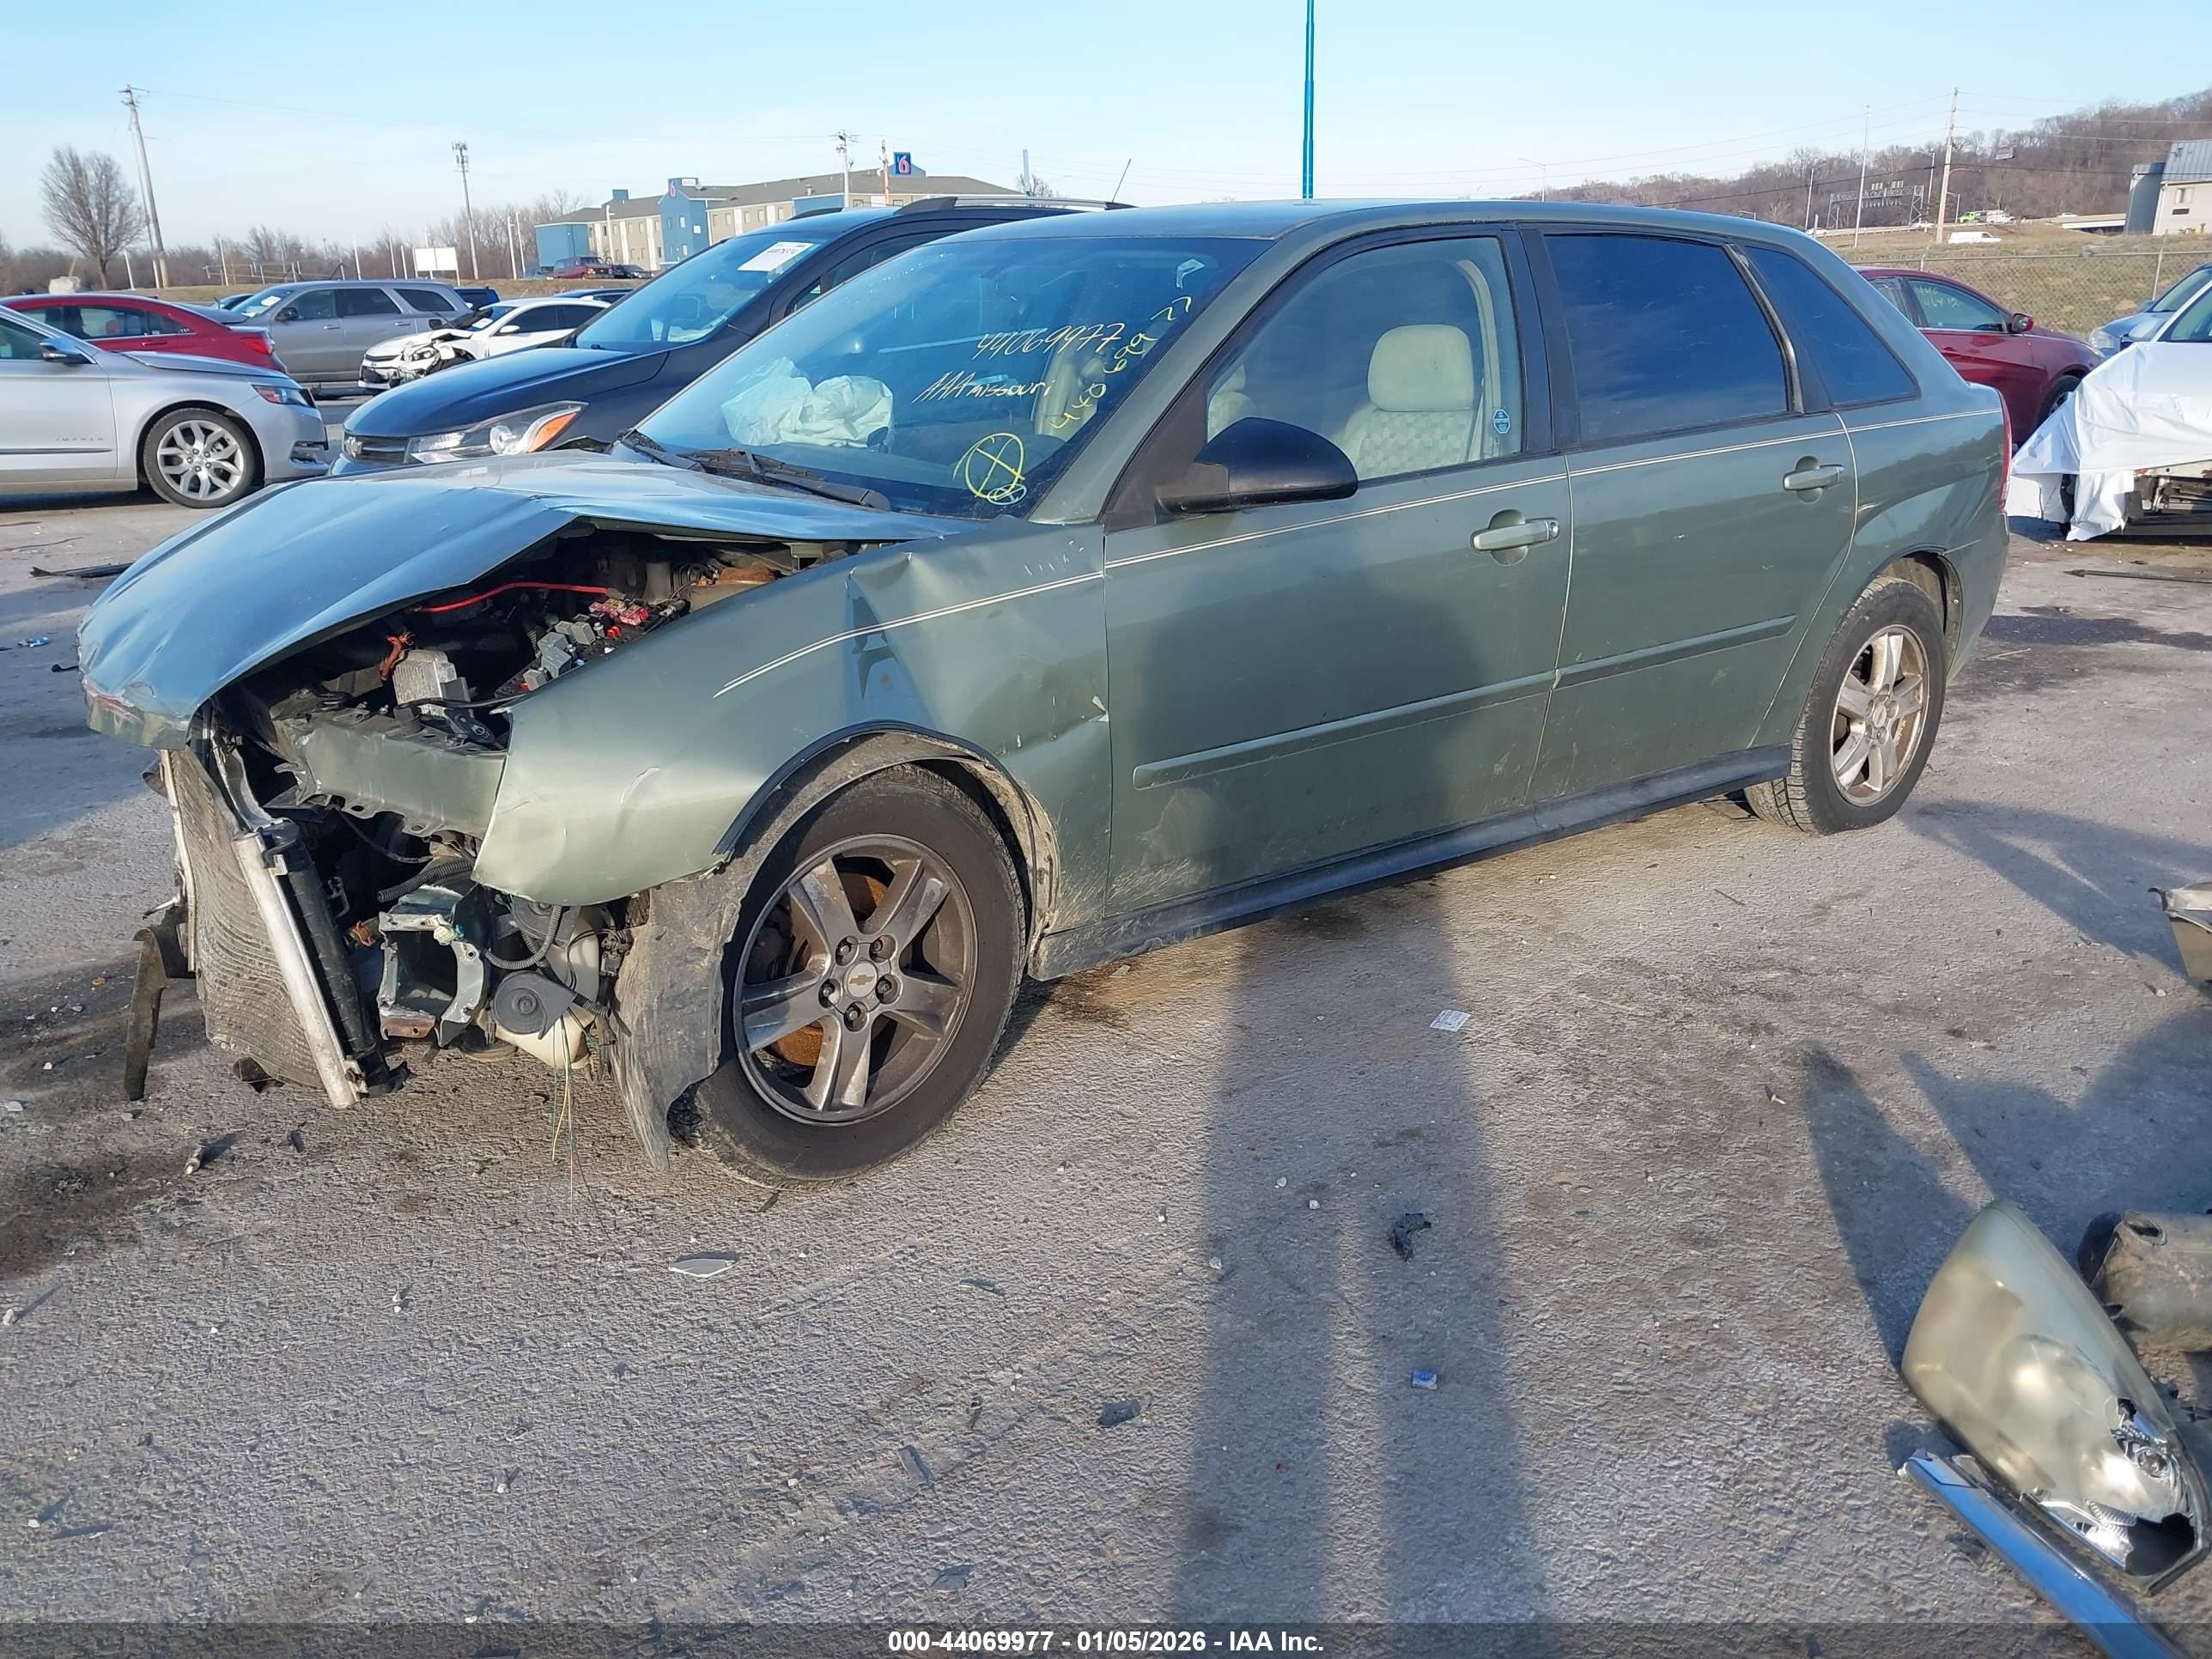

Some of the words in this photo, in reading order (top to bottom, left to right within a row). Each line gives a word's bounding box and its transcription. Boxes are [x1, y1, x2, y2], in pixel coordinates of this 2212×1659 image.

[899, 155, 909, 173] 6
[971, 322, 1126, 361] 44069977
[911, 370, 976, 404] AAA
